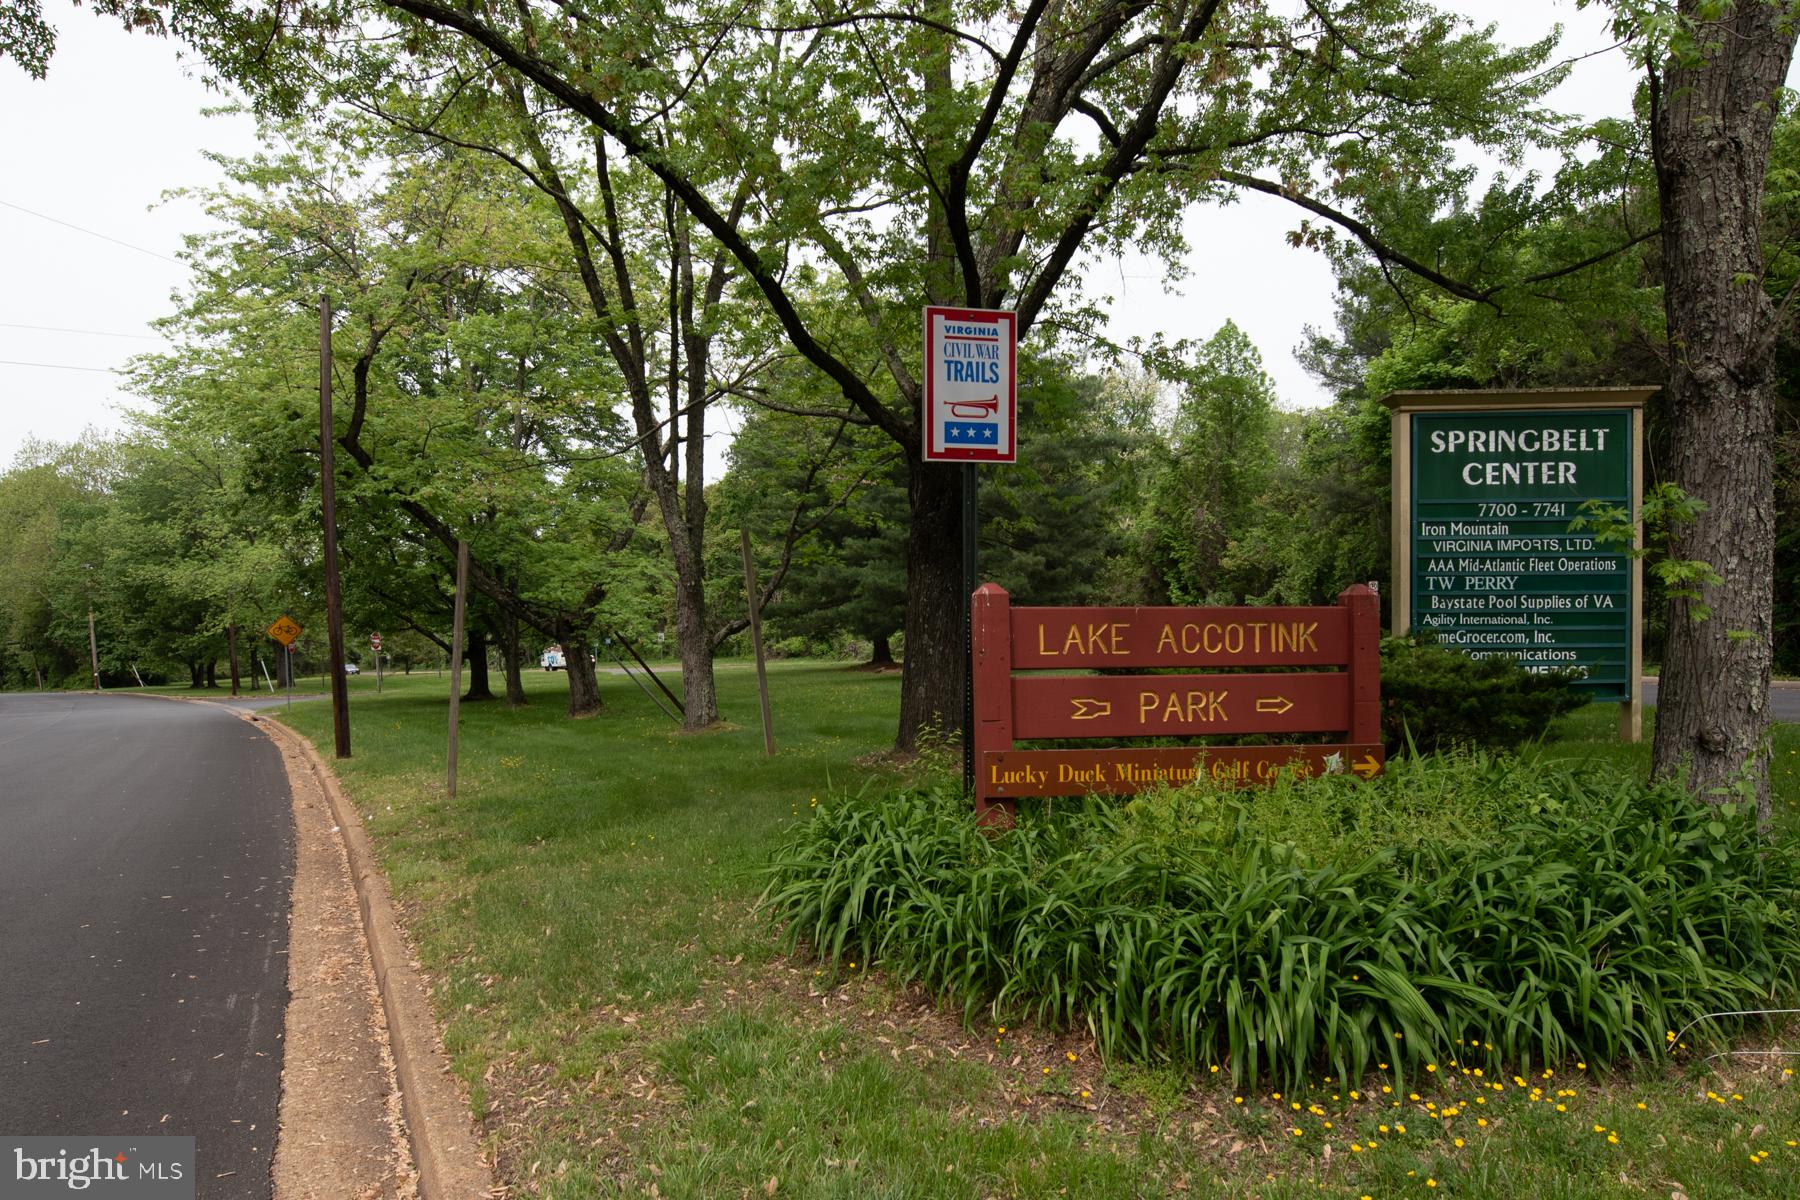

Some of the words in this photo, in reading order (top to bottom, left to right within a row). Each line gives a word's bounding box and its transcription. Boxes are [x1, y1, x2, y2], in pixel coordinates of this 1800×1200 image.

[944, 325, 998, 336] VIRGINIA
[944, 342, 974, 358] CIVIL
[976, 344, 999, 360] WAR
[944, 360, 999, 384] TRAILS
[1431, 429, 1610, 453] SPRINGBELT
[1462, 462, 1576, 486] CENTER
[1478, 504, 1517, 517] 7700
[1533, 503, 1566, 516] 7741
[1422, 522, 1446, 536] Iron
[1450, 522, 1508, 536] Mountain
[1433, 540, 1493, 552] VIRGINIA
[1566, 539, 1596, 550] LTD.
[1428, 560, 1454, 572] AAA
[1459, 558, 1525, 572] Mid-Atlantic
[1529, 558, 1554, 571] Fleet
[1558, 558, 1616, 572] Operations
[1426, 576, 1455, 590] TW
[1465, 576, 1518, 590] PERRY
[1432, 596, 1484, 610] Baystate
[1489, 596, 1516, 608] Pool
[1521, 595, 1571, 610] Supplies
[1576, 595, 1588, 608] of
[1594, 595, 1614, 608] VA
[1423, 614, 1456, 626] Agility
[1460, 613, 1530, 625] International,
[1534, 613, 1553, 624] Inc.
[1039, 624, 1130, 655] LAKE
[1157, 622, 1318, 654] ACCOTINK
[1432, 630, 1530, 644] omeGrocer.com,
[1534, 631, 1555, 643] Inc.
[1140, 691, 1228, 723] PARK
[991, 765, 1048, 788] Lucky
[1058, 763, 1106, 783] Duck
[1115, 762, 1201, 782] Miniatur
[1256, 760, 1314, 779] Cose
